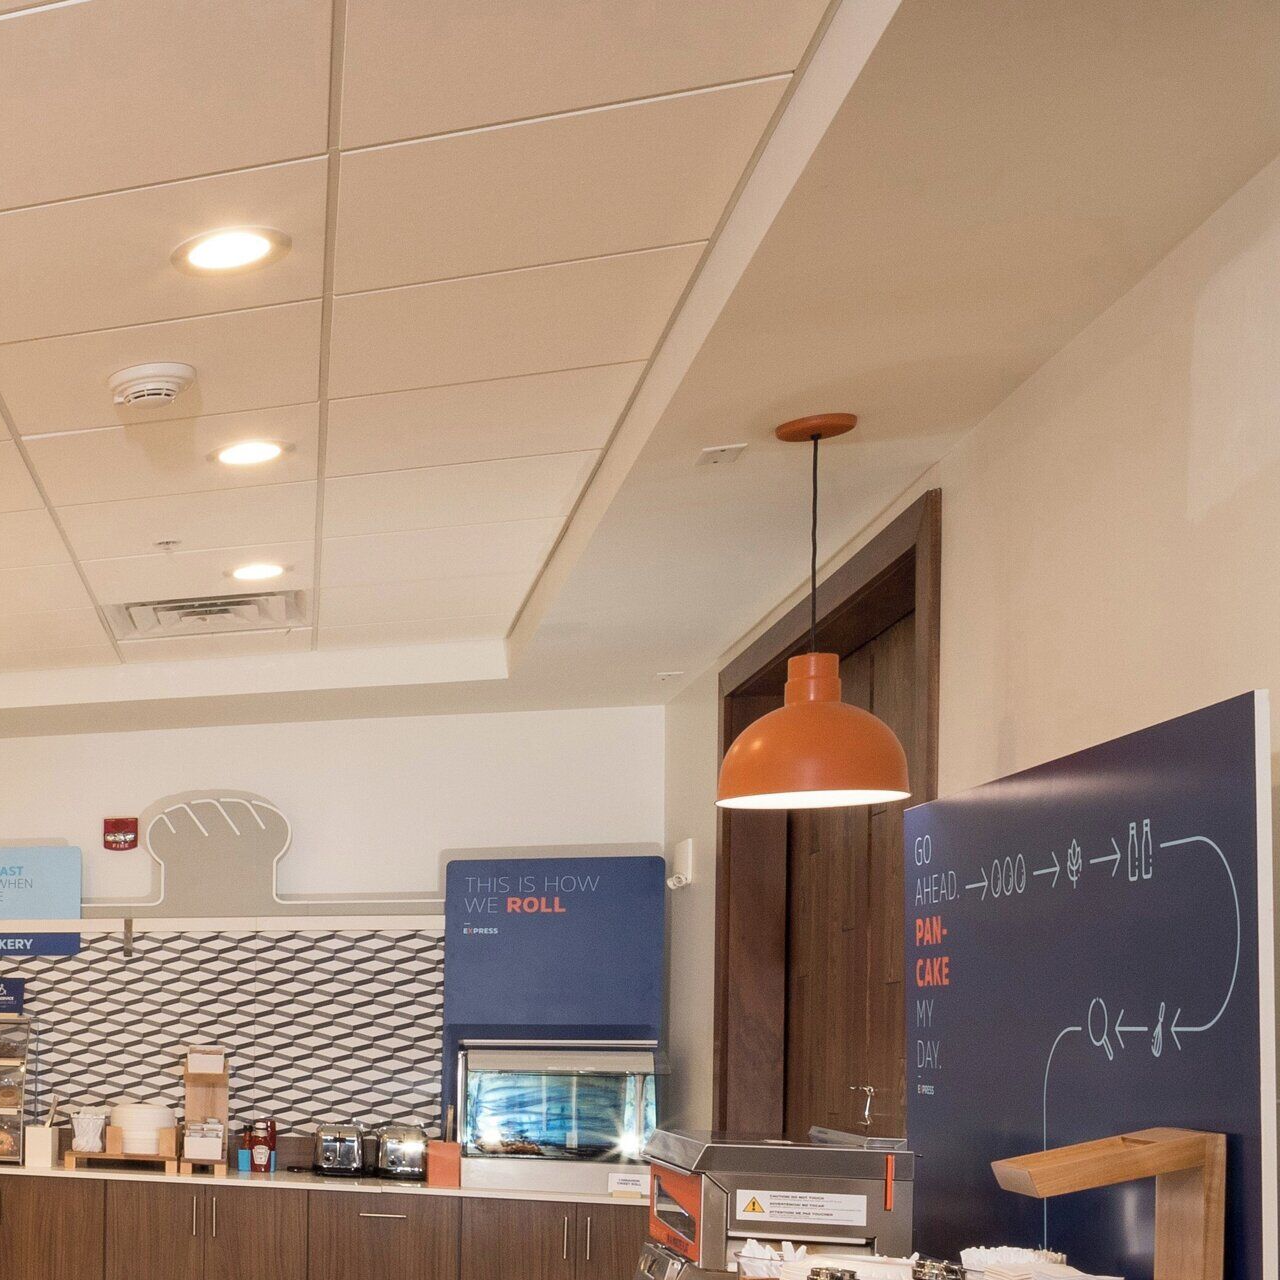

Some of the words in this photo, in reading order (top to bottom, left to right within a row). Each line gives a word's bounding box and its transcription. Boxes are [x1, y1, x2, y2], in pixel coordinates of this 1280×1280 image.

[914, 834, 932, 867] GO
[465, 876, 510, 893] THIS
[518, 876, 536, 893] IS
[544, 875, 600, 893] HOW
[915, 870, 961, 907] AHEAD.
[464, 897, 498, 914] WE
[506, 896, 567, 914] ROLL
[463, 927, 498, 935] EXPRESS
[915, 915, 948, 947] PAN-
[916, 956, 950, 988] CAKE
[916, 999, 934, 1029] MY
